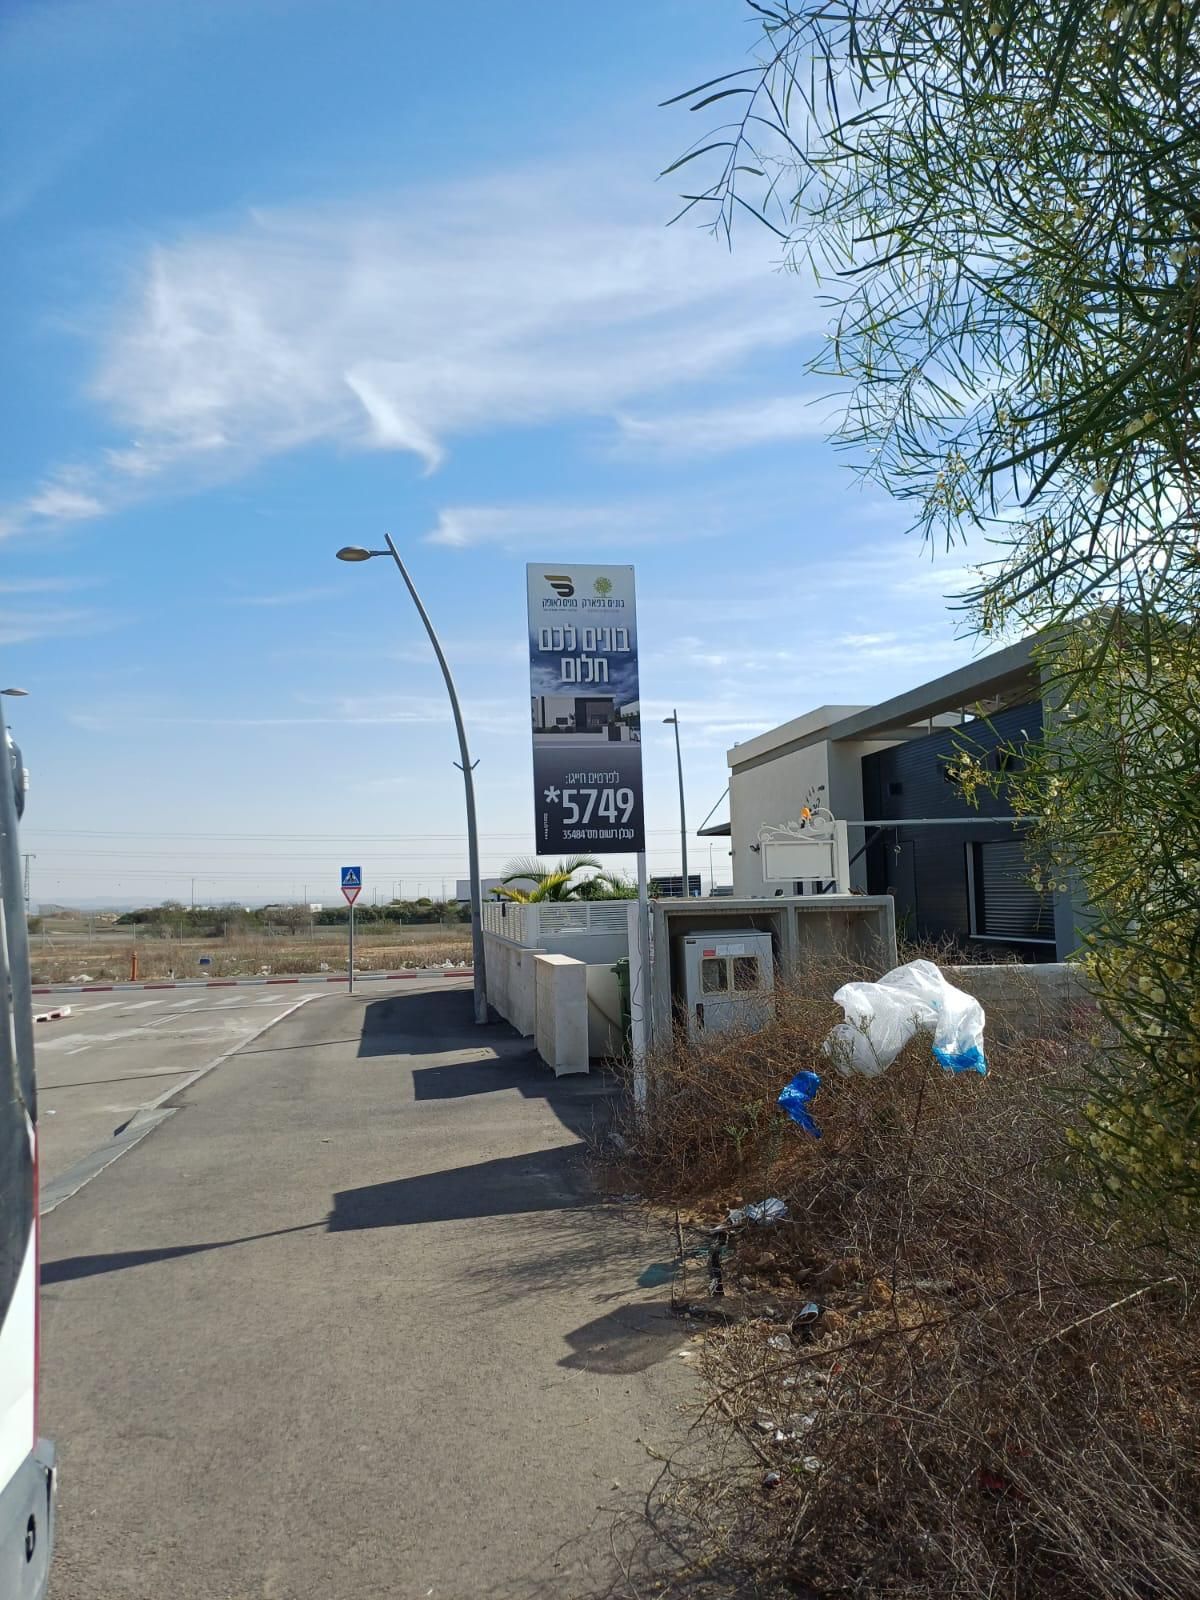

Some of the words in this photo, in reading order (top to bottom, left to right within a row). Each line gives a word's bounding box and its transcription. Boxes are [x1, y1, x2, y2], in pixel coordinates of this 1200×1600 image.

[542, 598, 562, 608] לאופק
[562, 598, 578, 608] בונים
[581, 598, 606, 609] בפארק
[607, 599, 625, 608] בונים
[538, 624, 576, 652] לכם
[582, 626, 631, 652] בונים
[560, 654, 609, 683] חלום
[565, 772, 587, 784] חייגו:
[588, 770, 620, 784] לפרטים
[562, 829, 585, 840] 35484
[599, 829, 618, 839] רשום
[618, 828, 635, 840] קבלן
